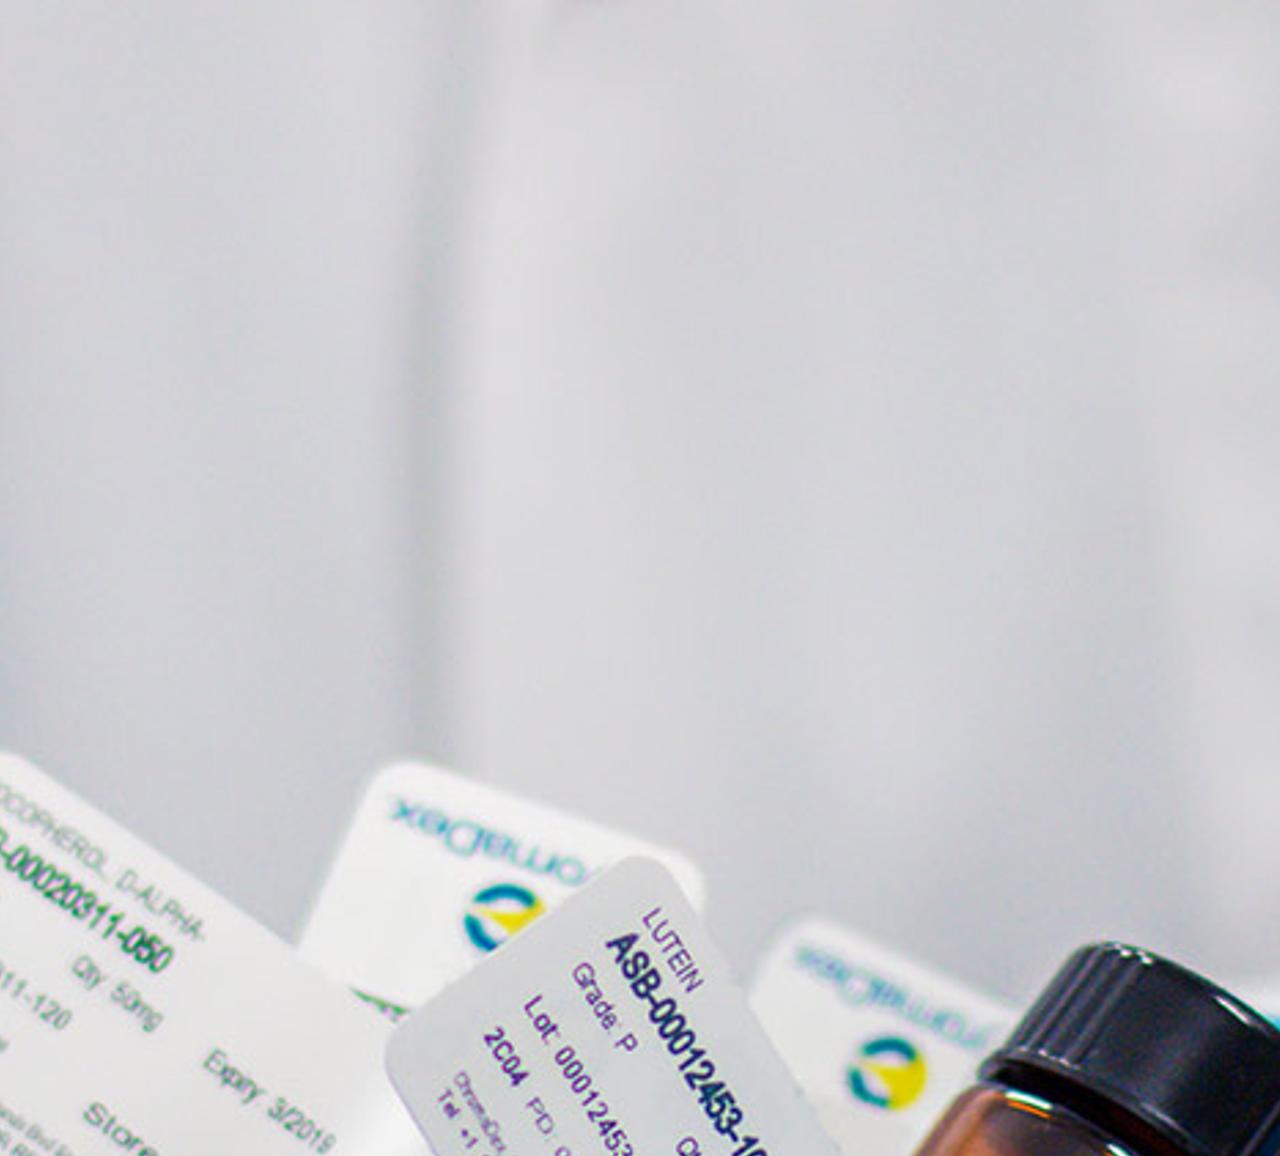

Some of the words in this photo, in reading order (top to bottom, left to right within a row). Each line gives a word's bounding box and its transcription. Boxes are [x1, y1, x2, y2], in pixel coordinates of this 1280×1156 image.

[392, 800, 585, 885] omaDex
[642, 907, 704, 994] LUTEIN
[111, 982, 162, 1033] 50mg
[523, 994, 559, 1043] Lot:
[483, 1027, 529, 1087] 2C04
[614, 1032, 639, 1052] P
